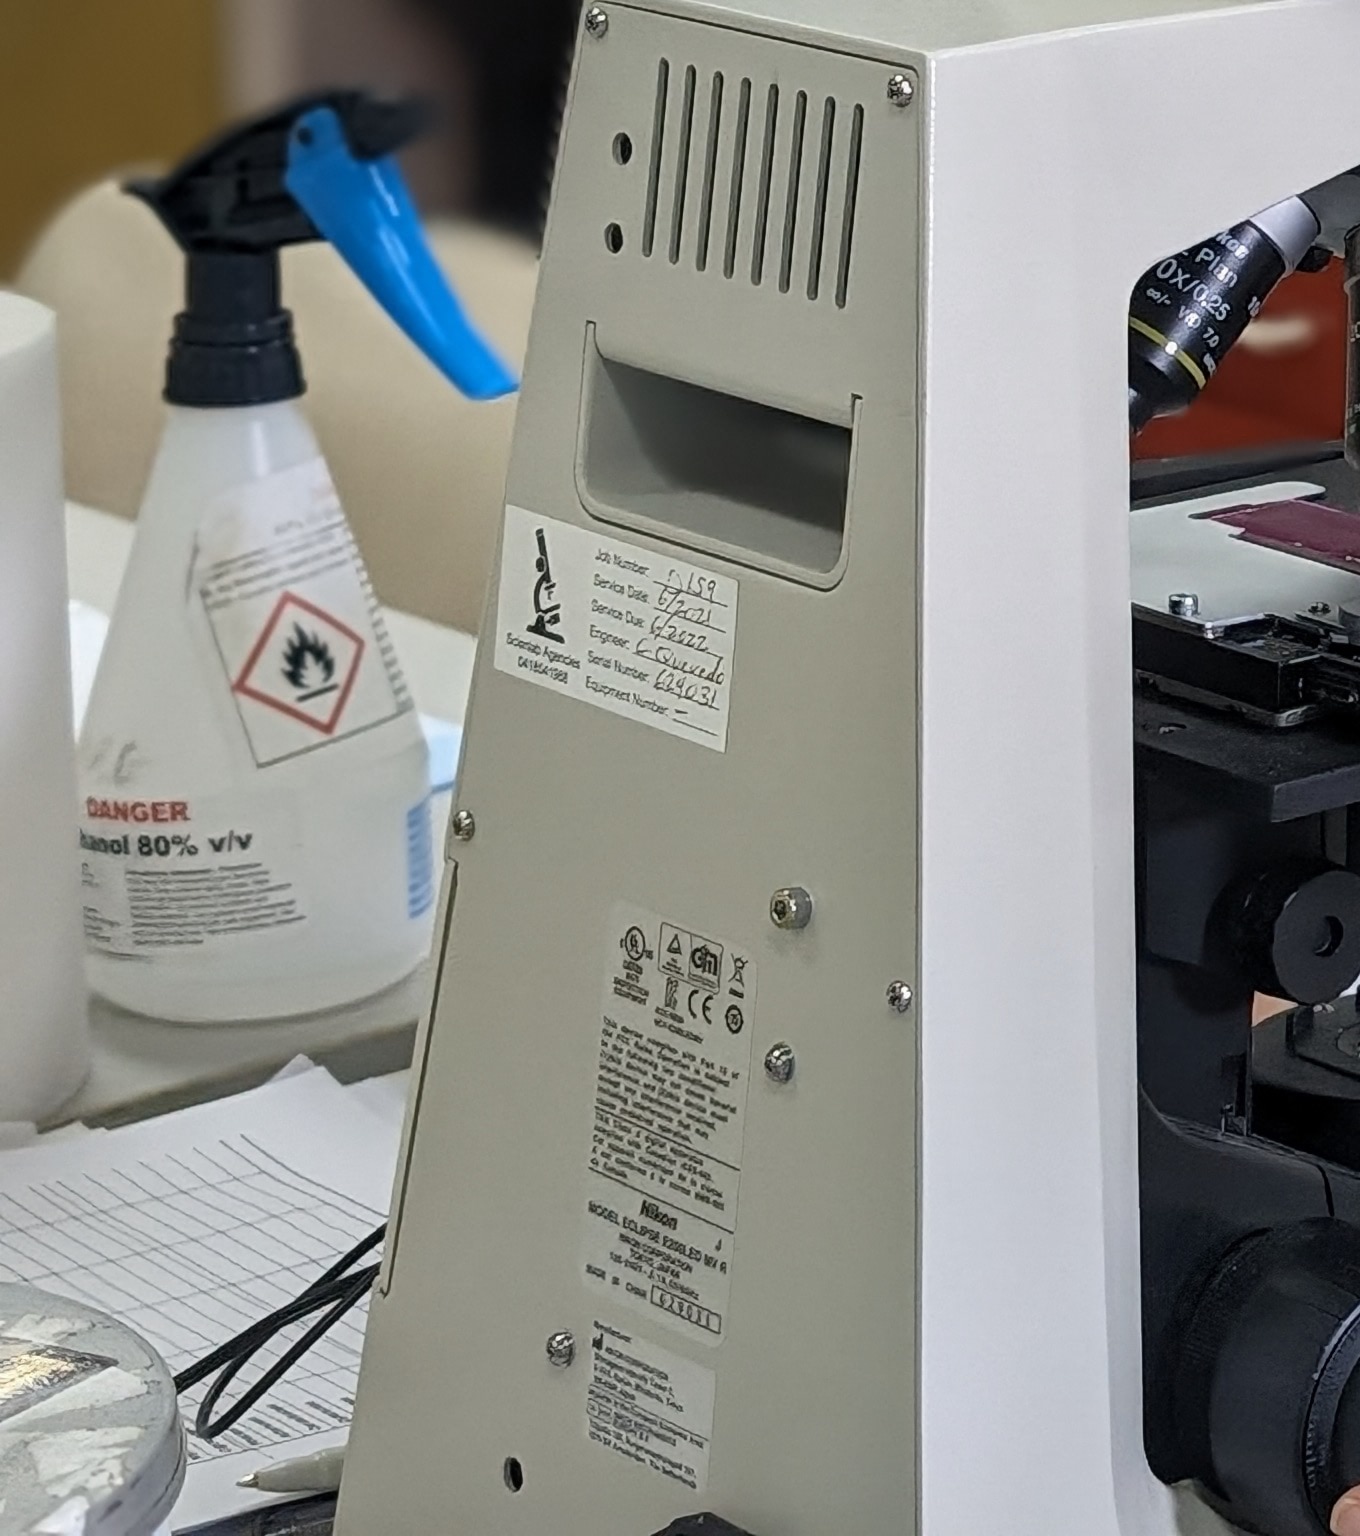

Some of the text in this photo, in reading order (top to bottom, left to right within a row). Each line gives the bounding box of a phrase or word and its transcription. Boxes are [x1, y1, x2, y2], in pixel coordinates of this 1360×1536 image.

[1215, 231, 1249, 259] kon
[1195, 248, 1238, 288] Plan
[1156, 258, 1231, 321] 0x/0.25
[86, 795, 191, 824] DANGER
[138, 833, 198, 856] 80%
[208, 830, 252, 852] v/v
